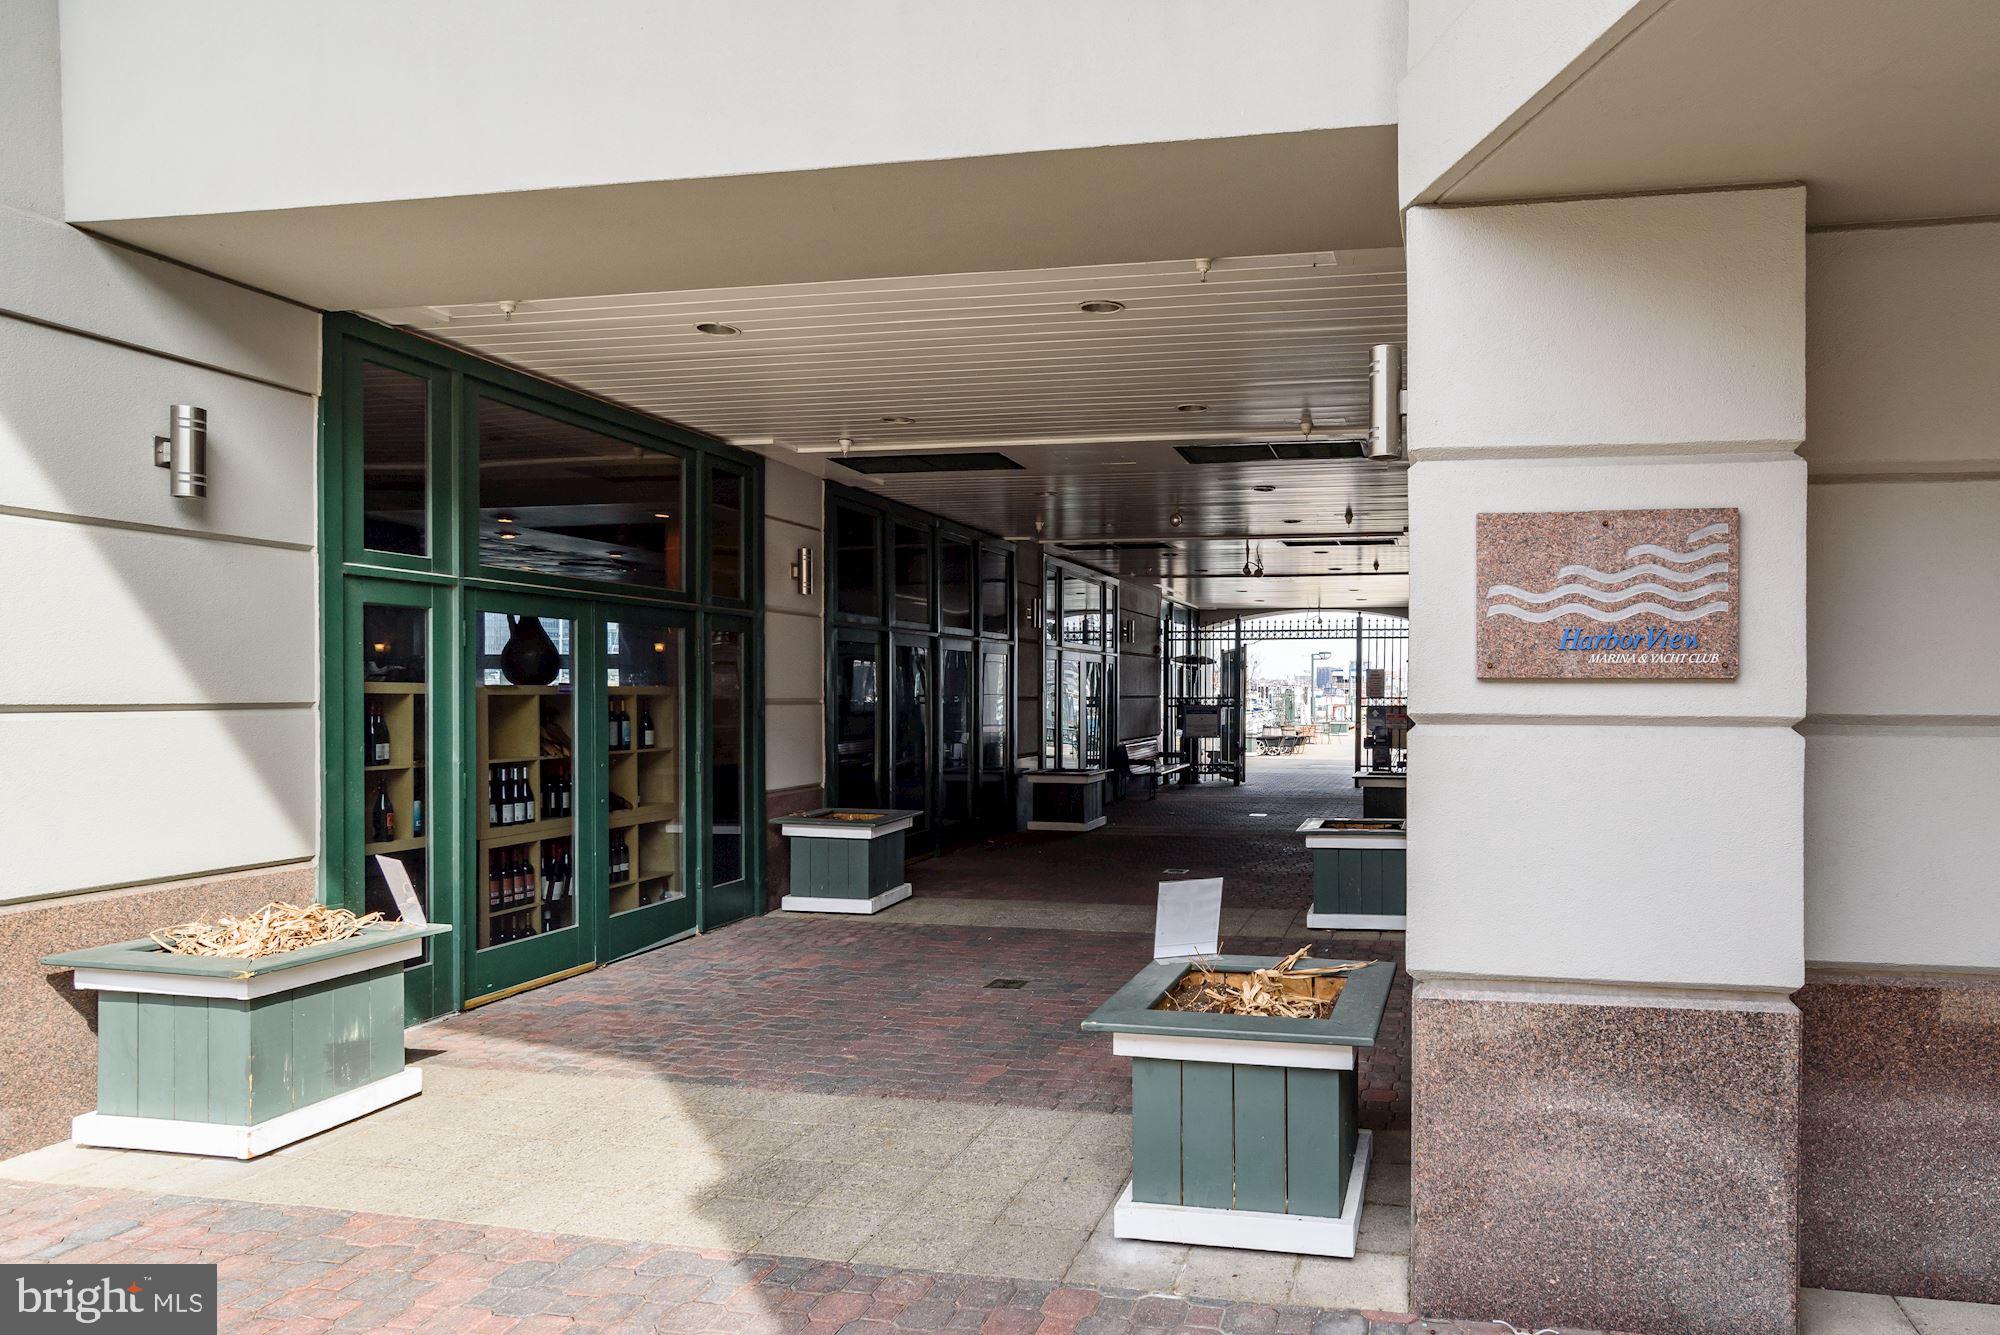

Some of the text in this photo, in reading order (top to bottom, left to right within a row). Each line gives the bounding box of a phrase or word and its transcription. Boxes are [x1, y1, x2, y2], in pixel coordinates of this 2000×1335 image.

[1558, 627, 1700, 651] HarborView
[1588, 653, 1720, 664] MARINA & YACHT CLUB
